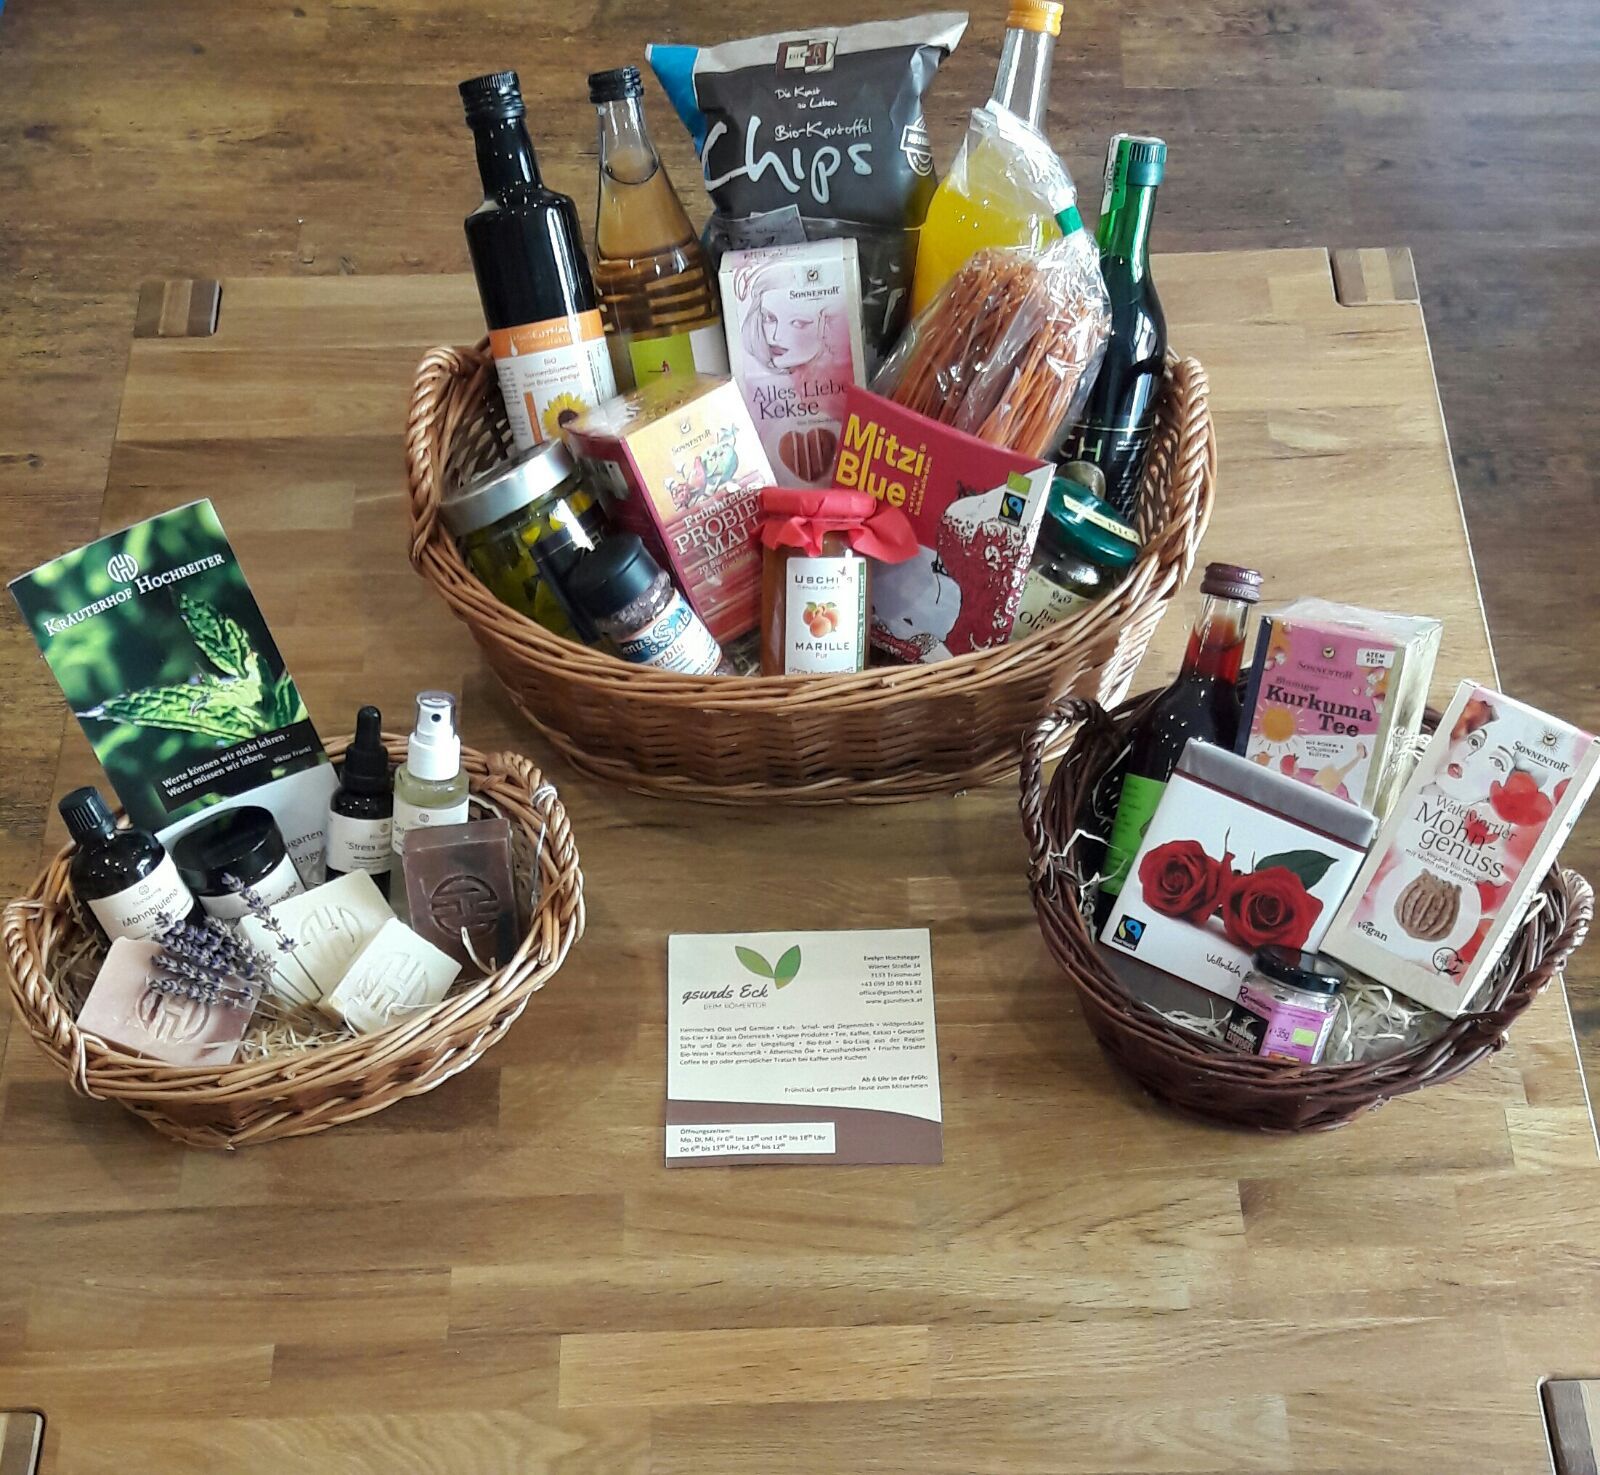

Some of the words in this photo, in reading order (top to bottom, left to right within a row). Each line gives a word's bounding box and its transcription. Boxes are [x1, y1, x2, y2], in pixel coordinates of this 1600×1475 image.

[775, 88, 791, 99] Die
[809, 98, 838, 108] Leben
[774, 118, 873, 142] Bio-Kartoffel
[702, 115, 872, 204] Chips
[753, 384, 797, 402] Alles
[759, 401, 820, 420] Kekse
[843, 413, 927, 477] Mitzi
[836, 447, 906, 506] Blue
[674, 494, 760, 555] PROBIE
[43, 588, 133, 637] KRÄUTERHOF
[135, 553, 226, 595] HOCHREITER
[795, 642, 850, 651] MARILLE
[1265, 684, 1373, 721] Kurkuma
[1318, 714, 1359, 737] Tee
[162, 772, 188, 788] Werte
[187, 760, 220, 776] können
[220, 752, 235, 763] wir
[235, 743, 258, 757] nicht
[258, 733, 286, 748] lehren
[166, 782, 193, 798] Werte
[193, 769, 225, 786] müssen
[225, 761, 241, 772] wir
[241, 753, 267, 767] leben.
[1414, 801, 1496, 851] Mohn-
[1418, 828, 1504, 878] genuss
[1357, 921, 1388, 941] vegan
[682, 984, 734, 1005] gsunds
[740, 984, 768, 998] Eck
[904, 1036, 925, 1044] Region
